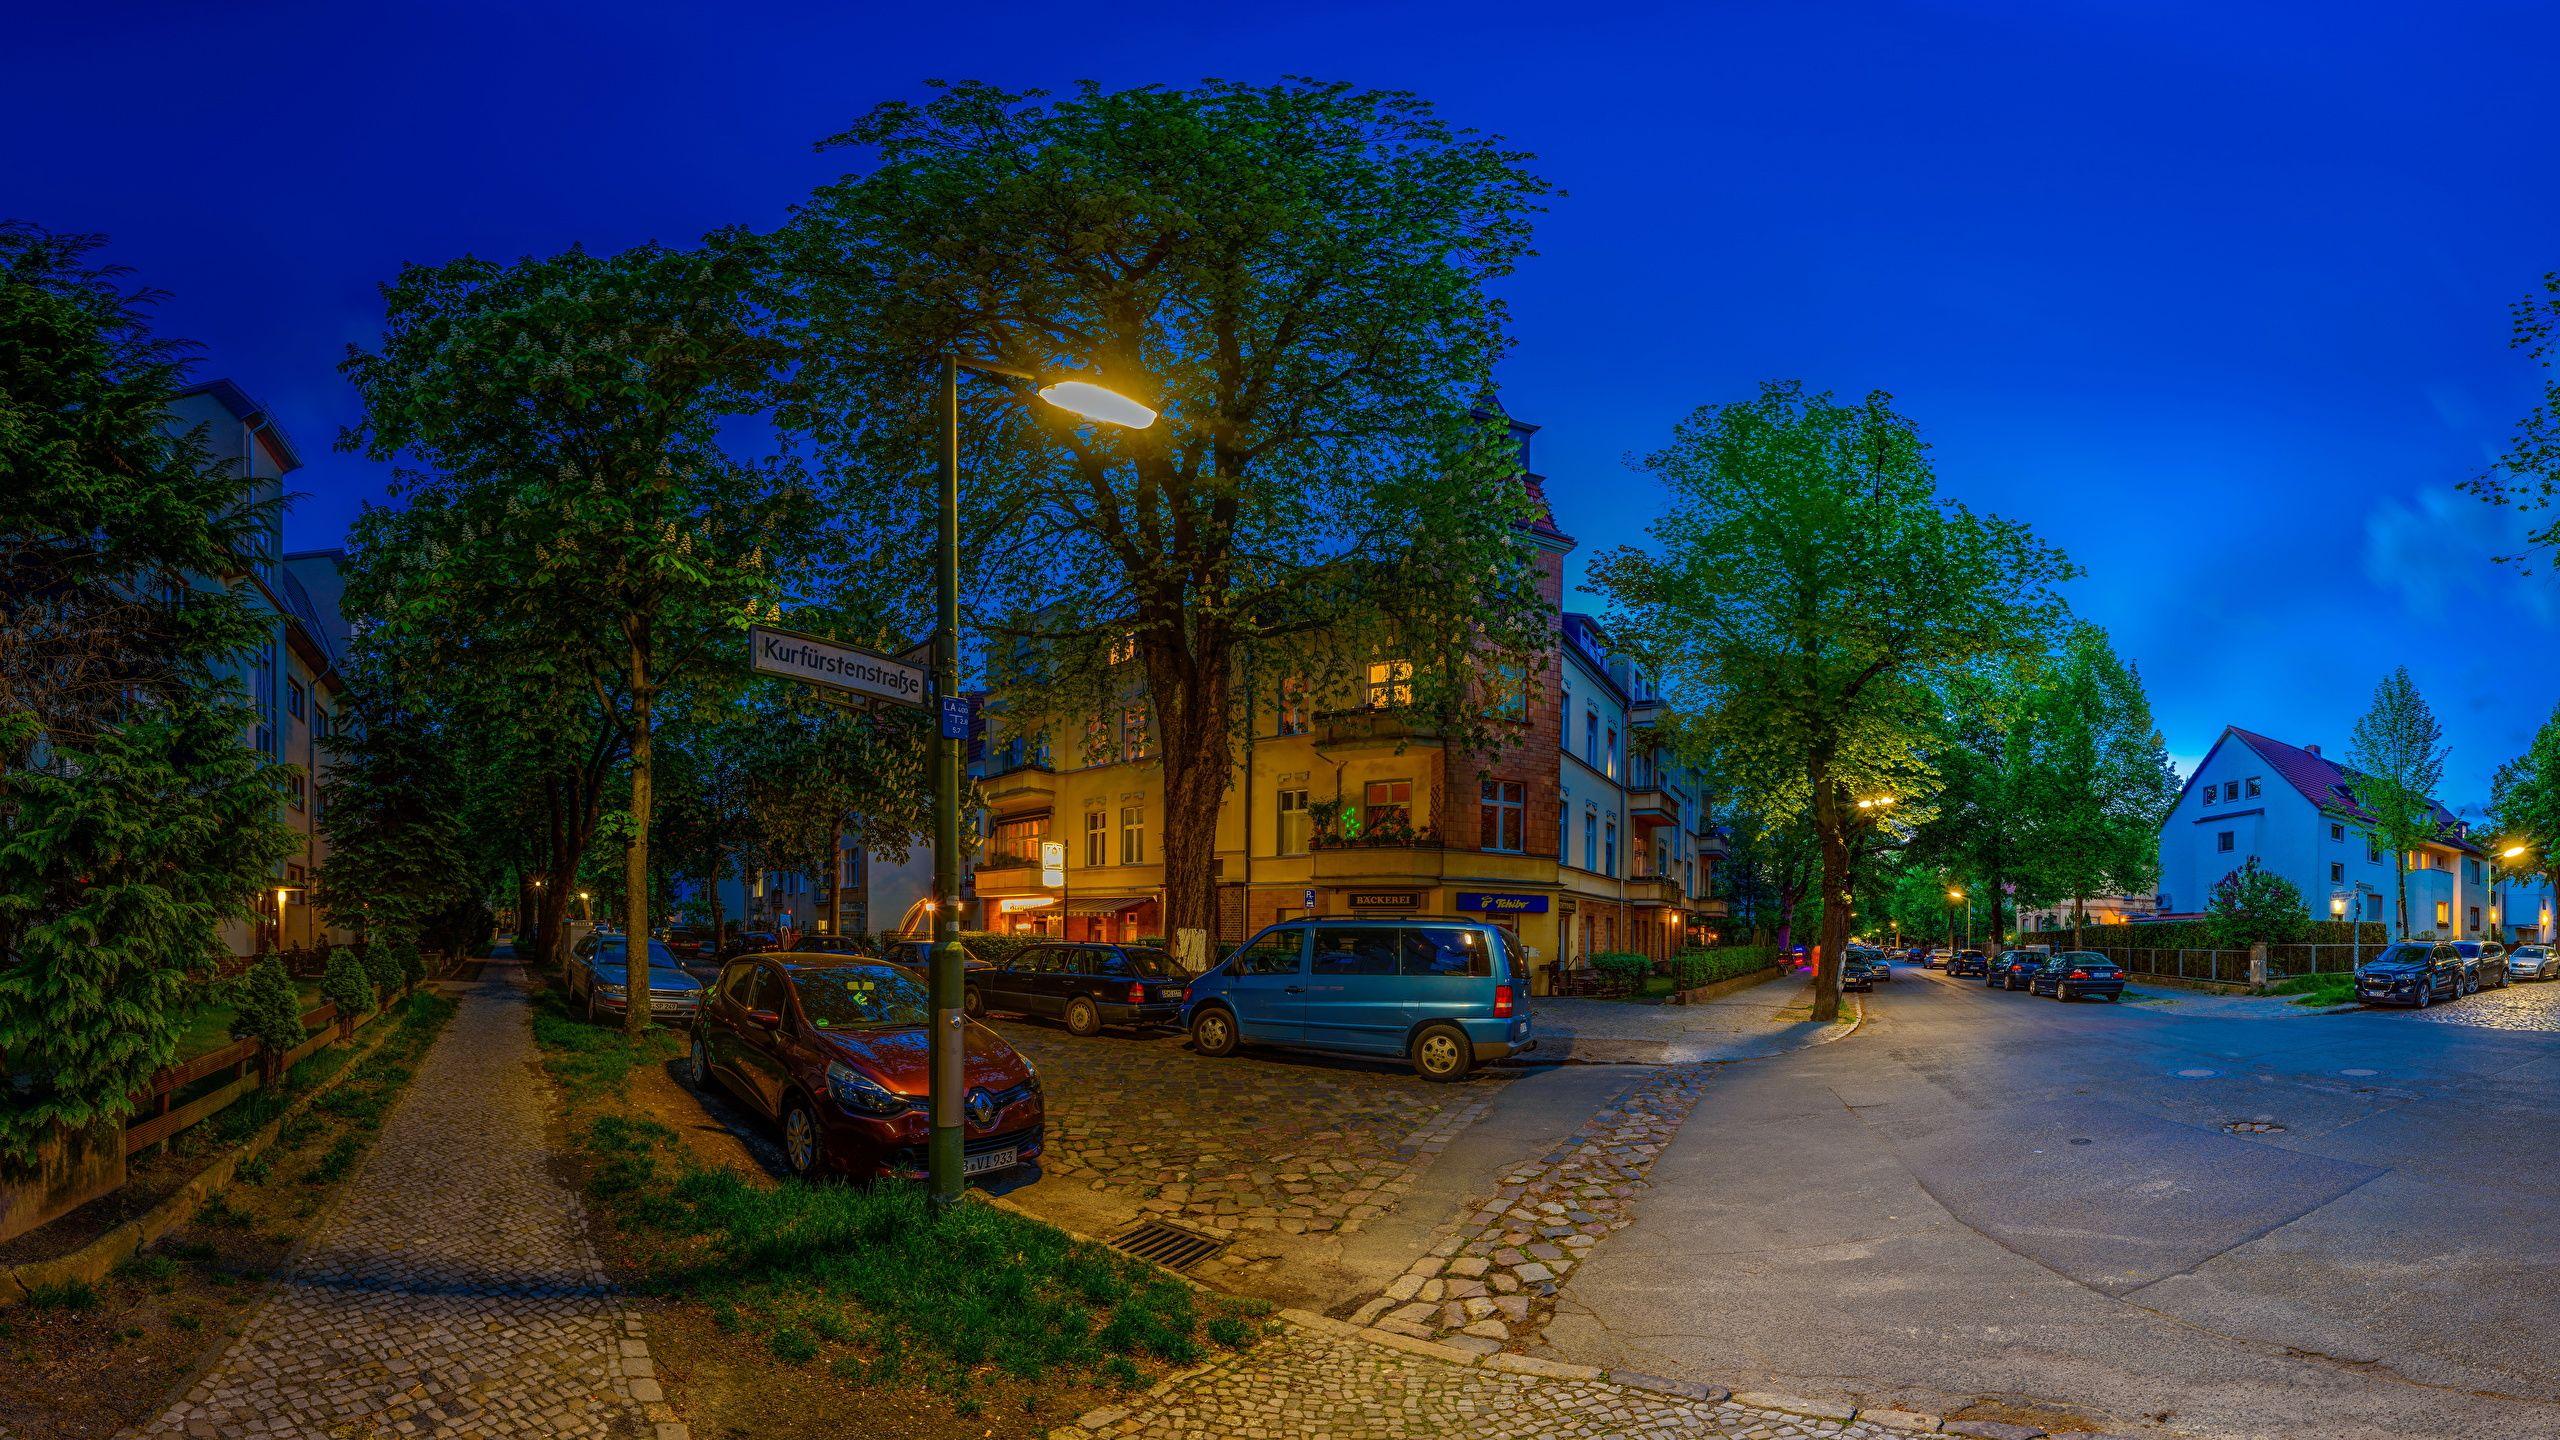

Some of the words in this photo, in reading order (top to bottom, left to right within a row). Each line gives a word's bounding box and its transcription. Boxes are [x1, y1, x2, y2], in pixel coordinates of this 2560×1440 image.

[764, 636, 919, 695] Kurfürstenstraße
[1356, 895, 1411, 904] BÄCKEREI
[1495, 898, 1530, 909] Tchibo
[994, 1151, 1012, 1166] 933
